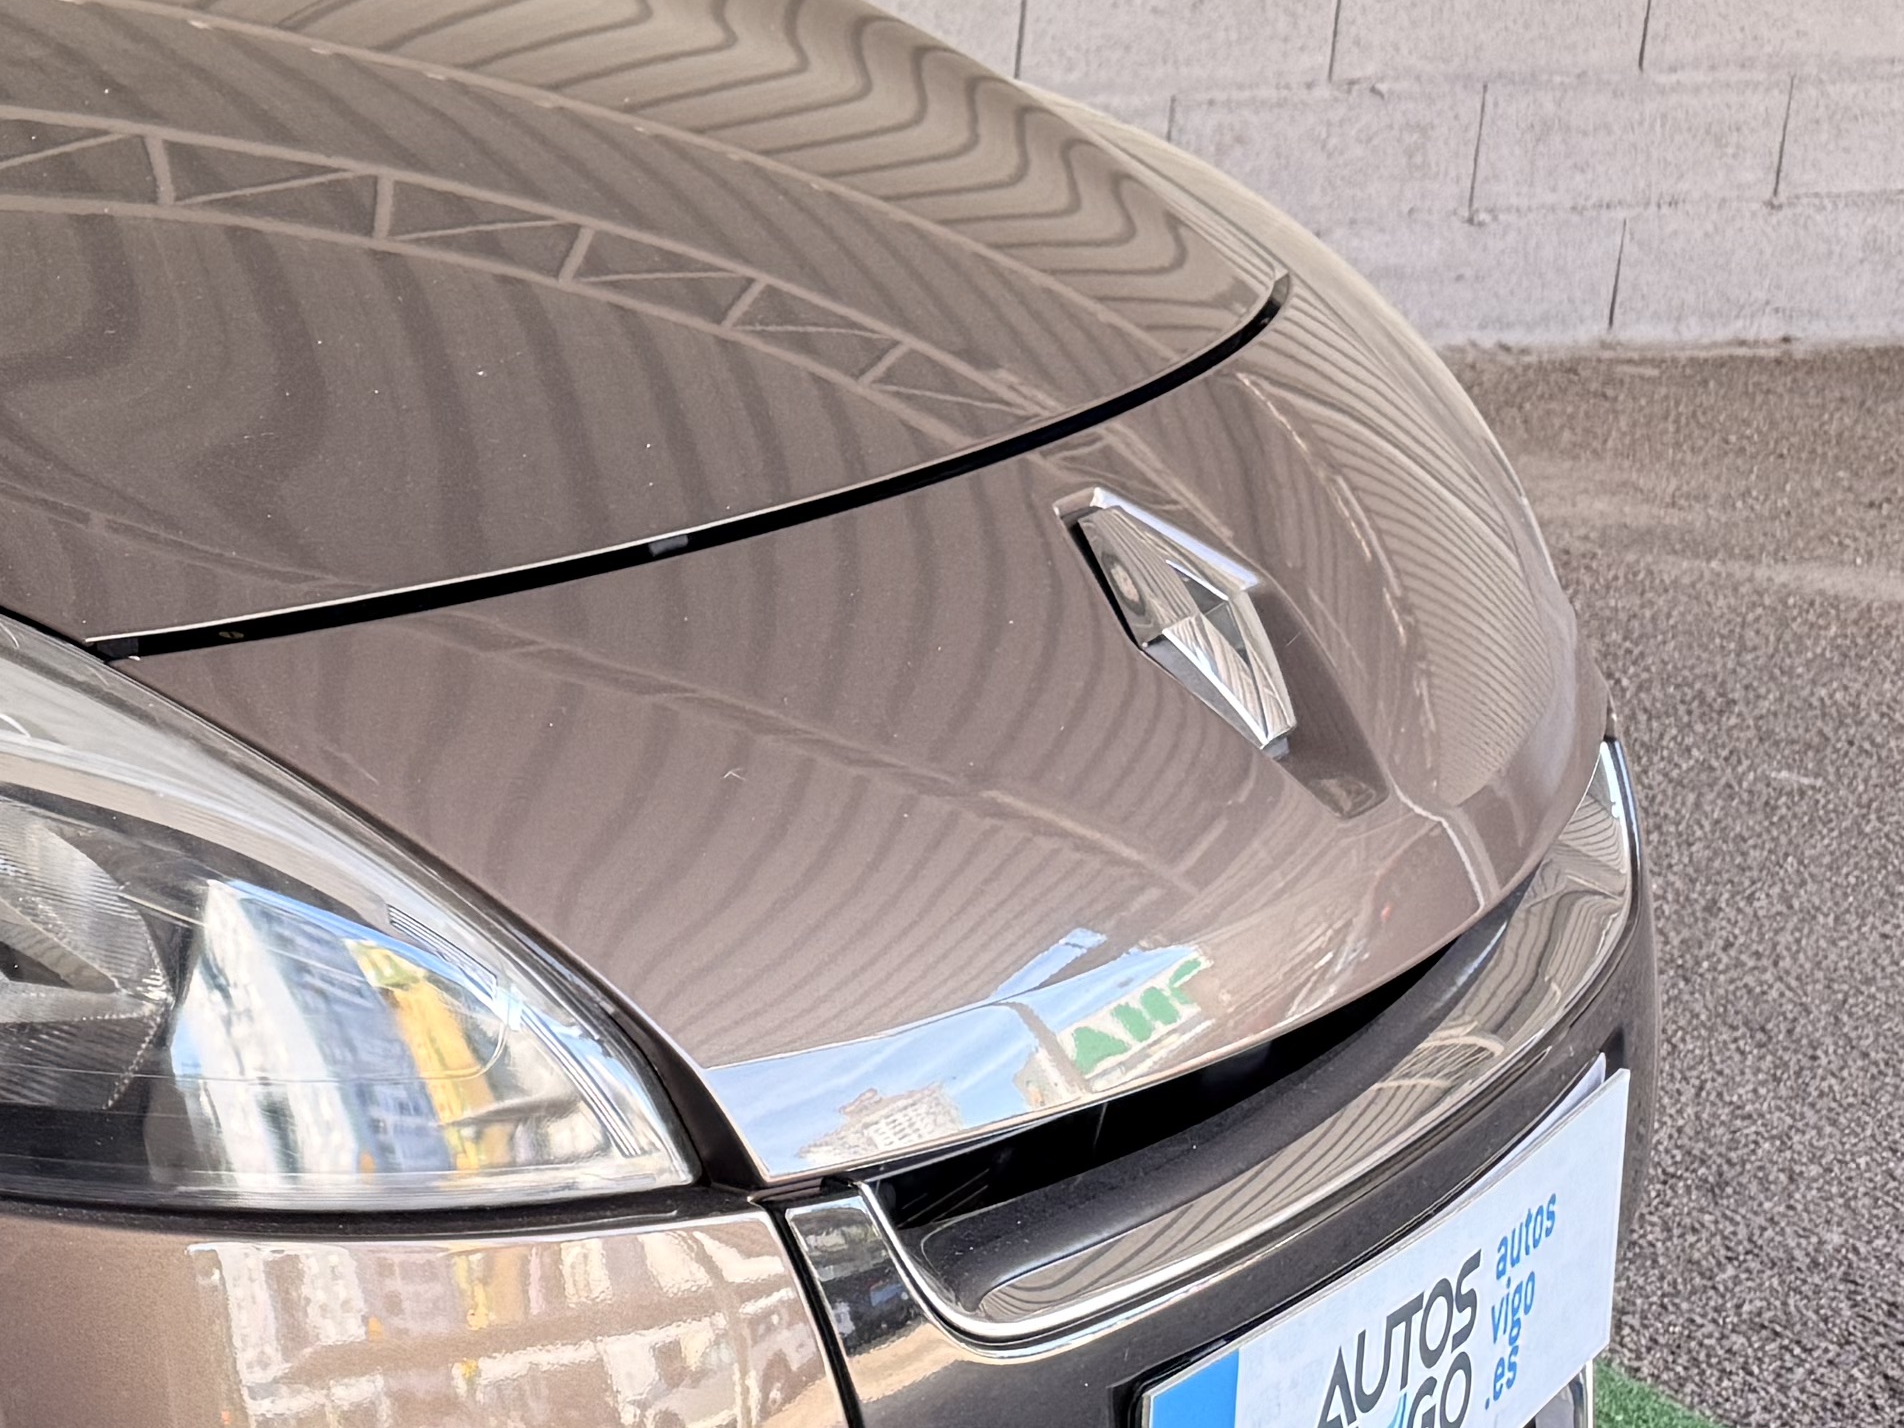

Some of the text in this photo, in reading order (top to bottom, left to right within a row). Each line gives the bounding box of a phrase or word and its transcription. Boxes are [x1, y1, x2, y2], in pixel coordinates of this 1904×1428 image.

[1495, 1193, 1557, 1281] autos
[1491, 1271, 1535, 1347] vigo
[1485, 1344, 1520, 1411] .es
